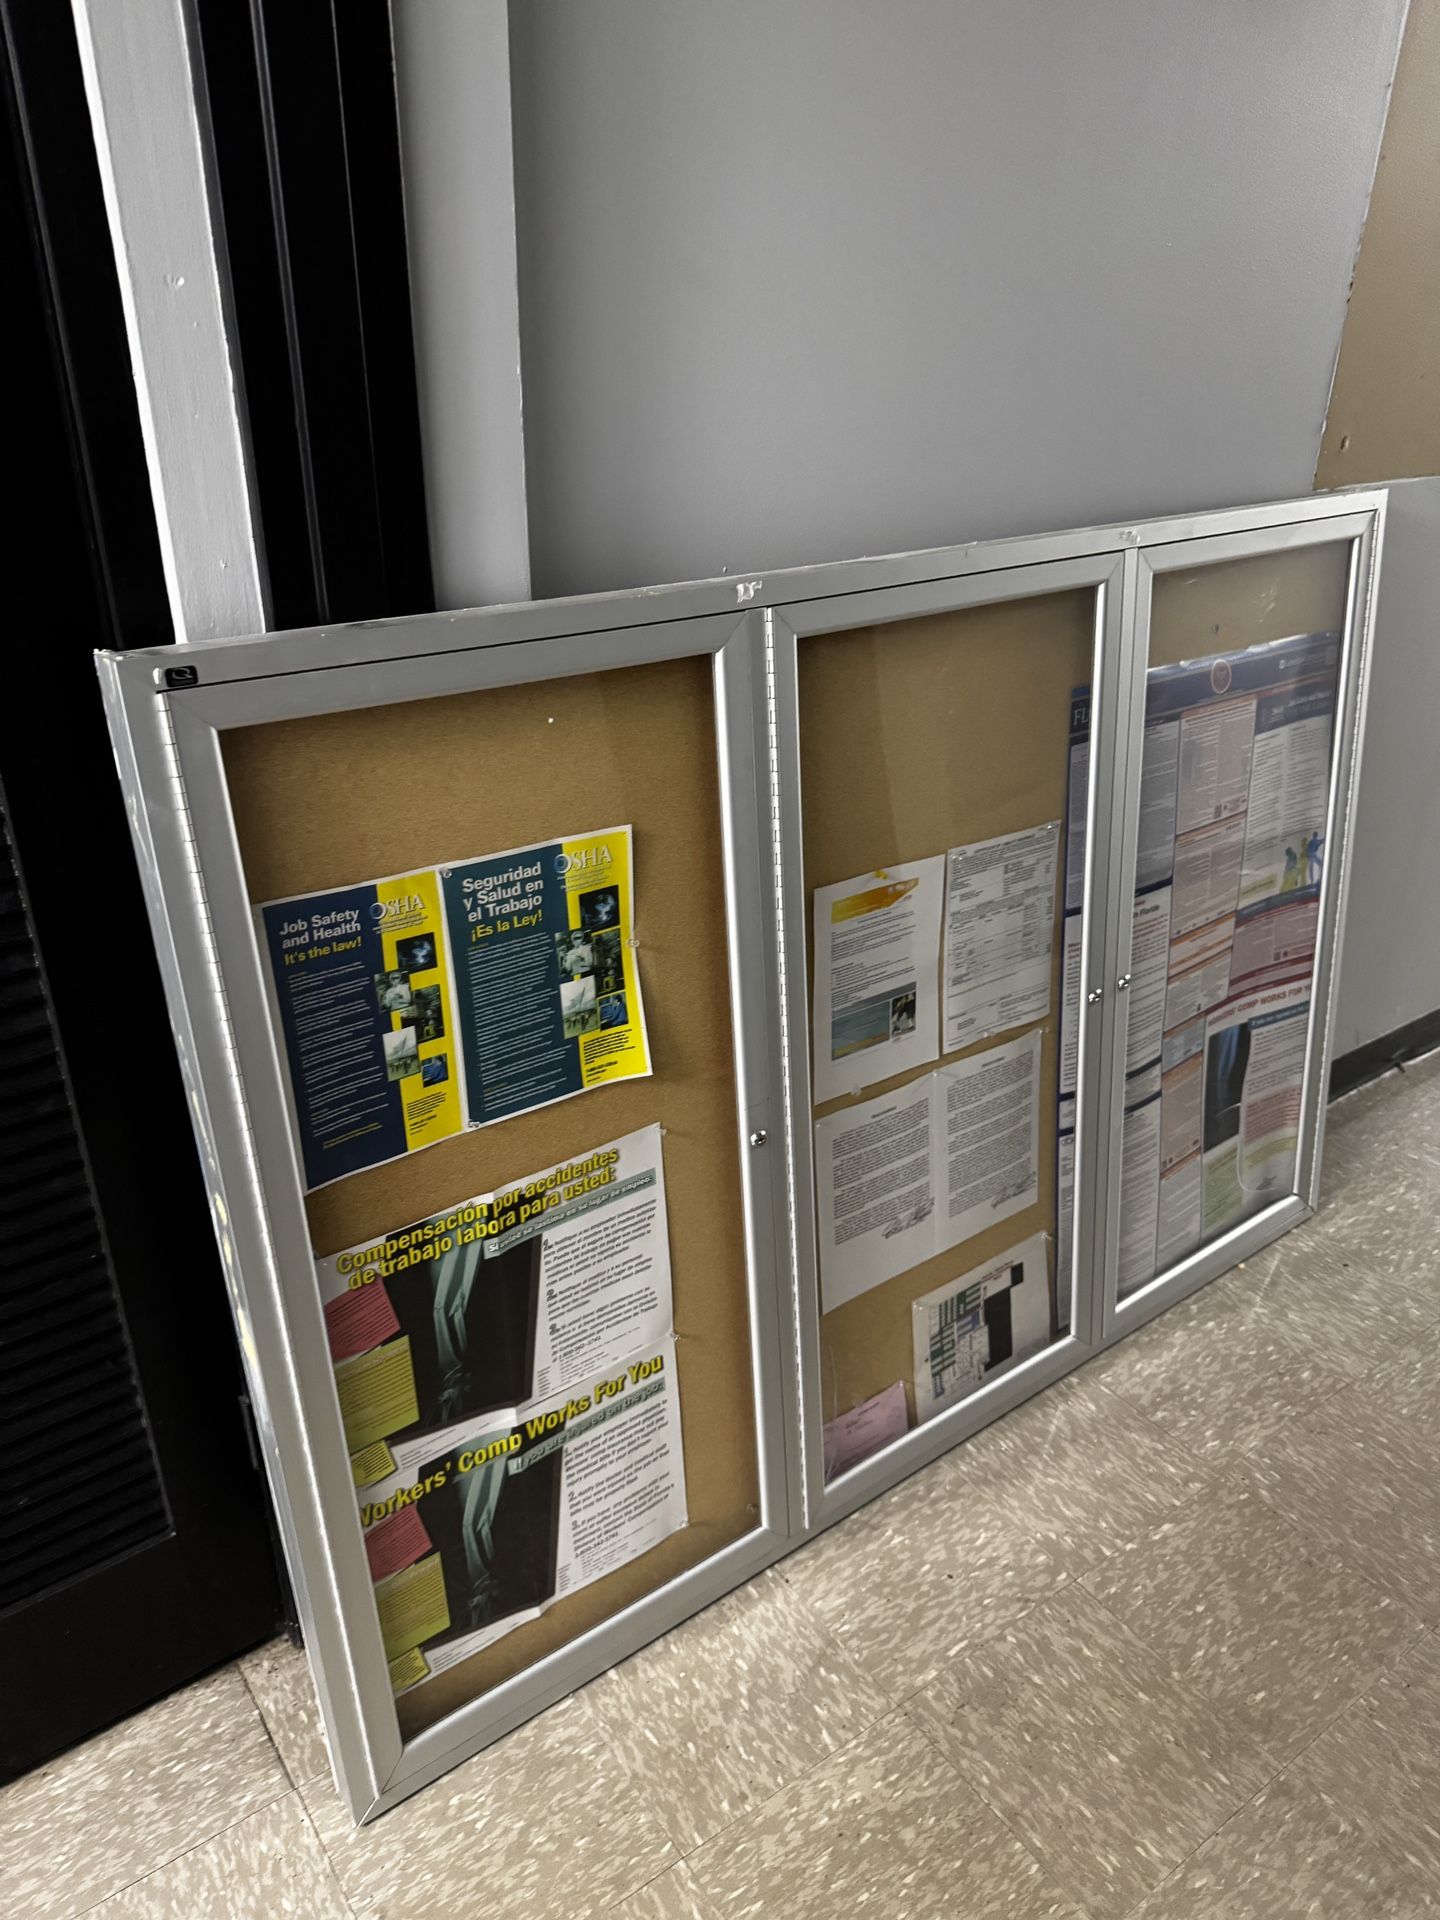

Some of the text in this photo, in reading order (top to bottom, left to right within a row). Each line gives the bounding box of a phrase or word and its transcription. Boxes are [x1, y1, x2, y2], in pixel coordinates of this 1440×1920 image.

[554, 845, 614, 874] OSHA
[462, 861, 542, 893] Seguridad
[369, 893, 426, 920] OSHA
[463, 879, 544, 911] y Salud en
[468, 894, 543, 923] el Trabajo
[280, 918, 308, 936] Job
[311, 909, 360, 929] Safety
[282, 933, 309, 949] and
[313, 922, 361, 940] Health
[471, 910, 543, 943] ¡Es la Ley!
[284, 936, 362, 966] It's the law!
[336, 1148, 620, 1275] Compensación por accidentes
[348, 1166, 618, 1290] de trabajo labora para usted:
[526, 1394, 591, 1440] Works
[592, 1375, 628, 1406] For
[628, 1353, 665, 1386] You
